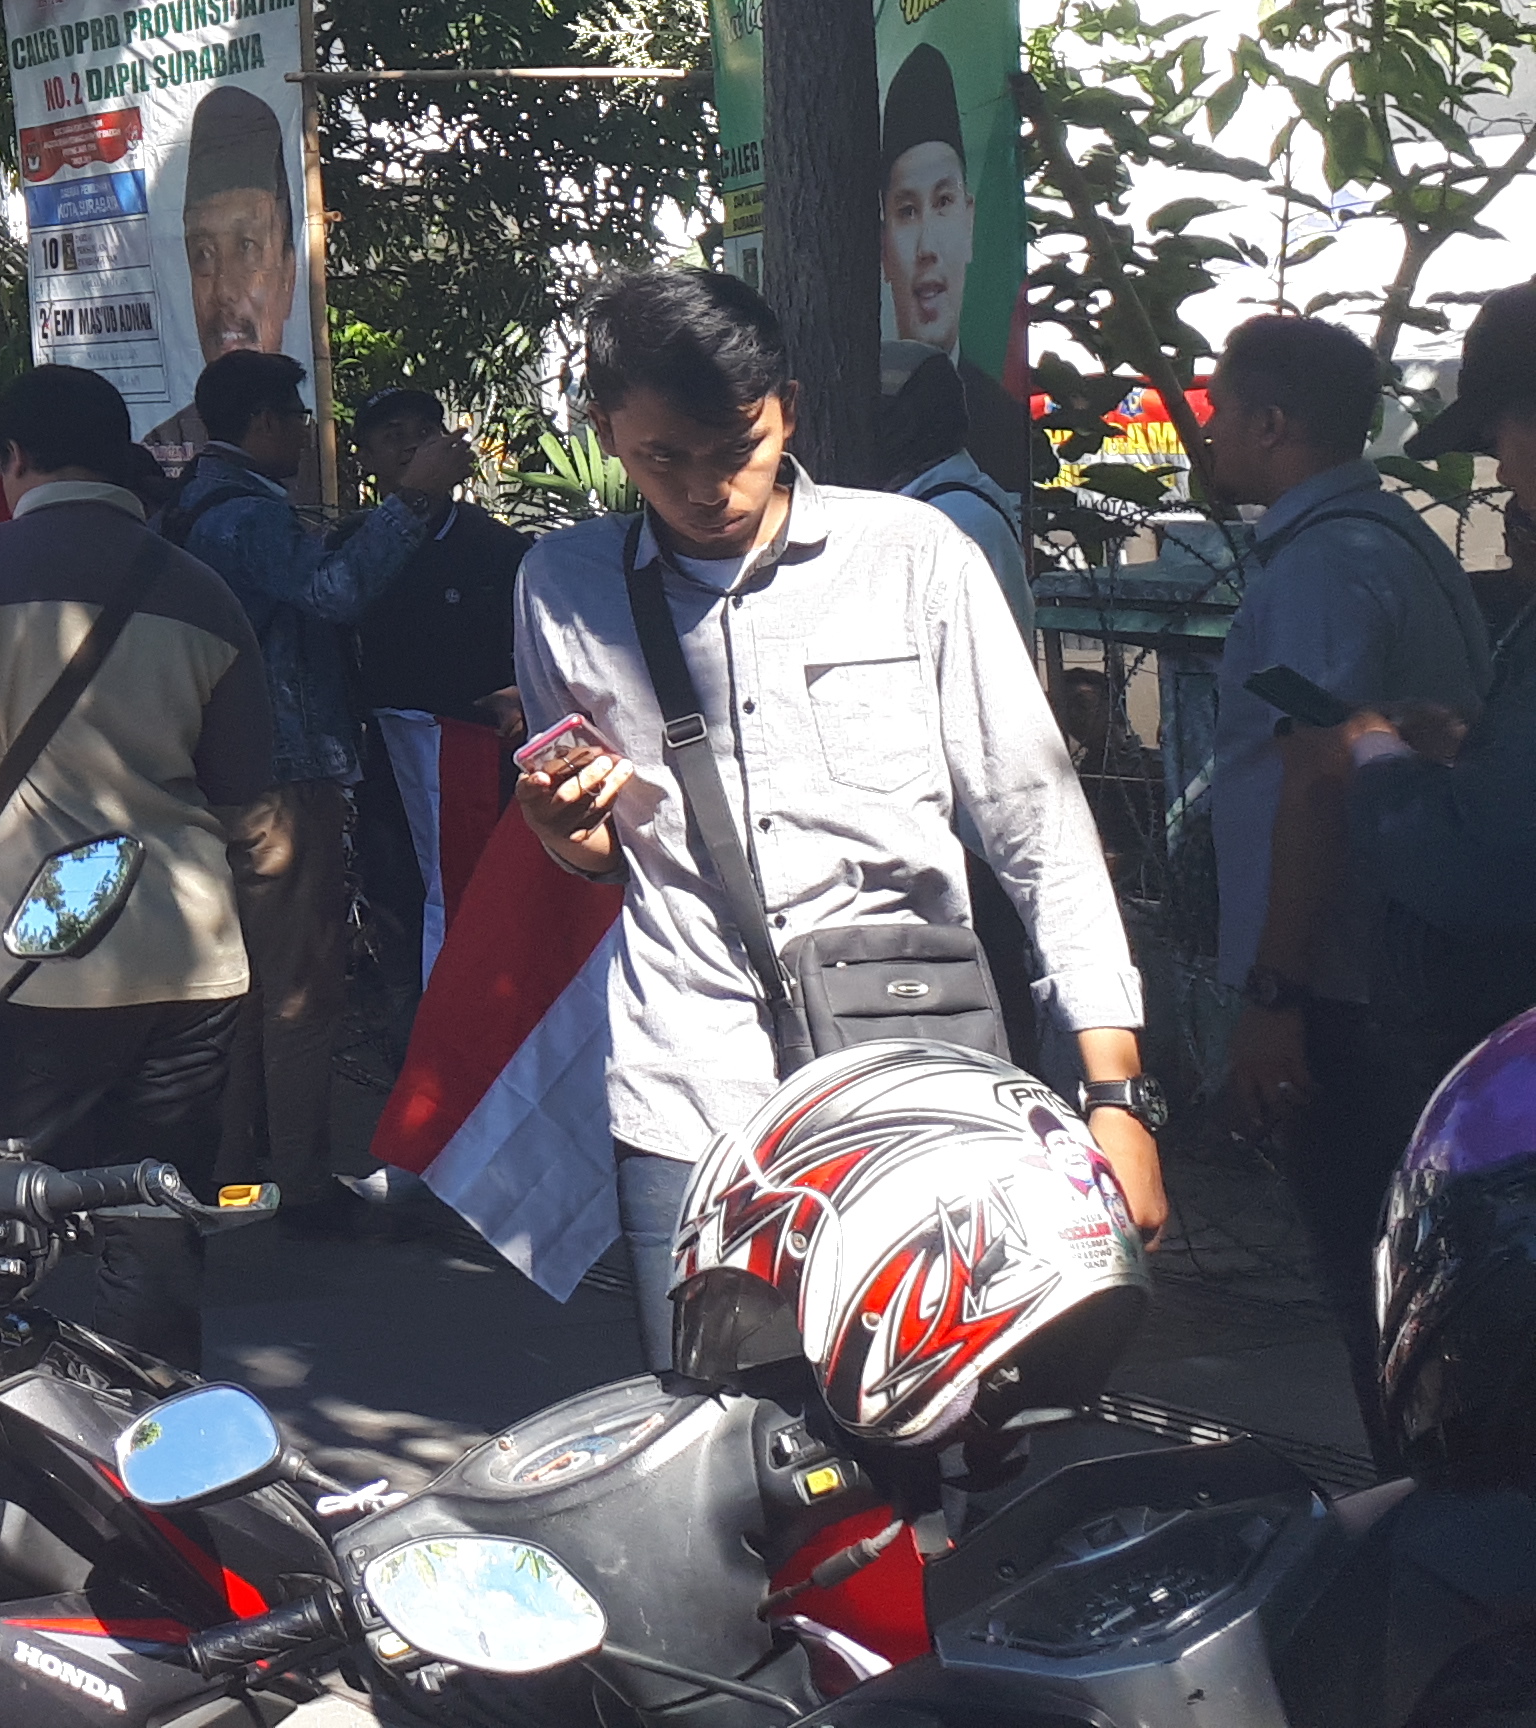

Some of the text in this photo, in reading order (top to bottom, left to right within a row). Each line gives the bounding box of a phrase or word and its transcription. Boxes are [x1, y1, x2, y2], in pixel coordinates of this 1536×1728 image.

[11, 27, 60, 71] CALEG
[61, 14, 121, 58] DPRD
[43, 32, 266, 112] NO. 2 DAPIL SURABAYA
[720, 140, 760, 180] CALEG
[57, 201, 79, 220] KOTA
[41, 237, 59, 270] 10
[39, 308, 50, 340] 2
[53, 307, 76, 338] EM
[118, 302, 153, 332] ADNAN
[13, 1639, 127, 1712] HONDA
